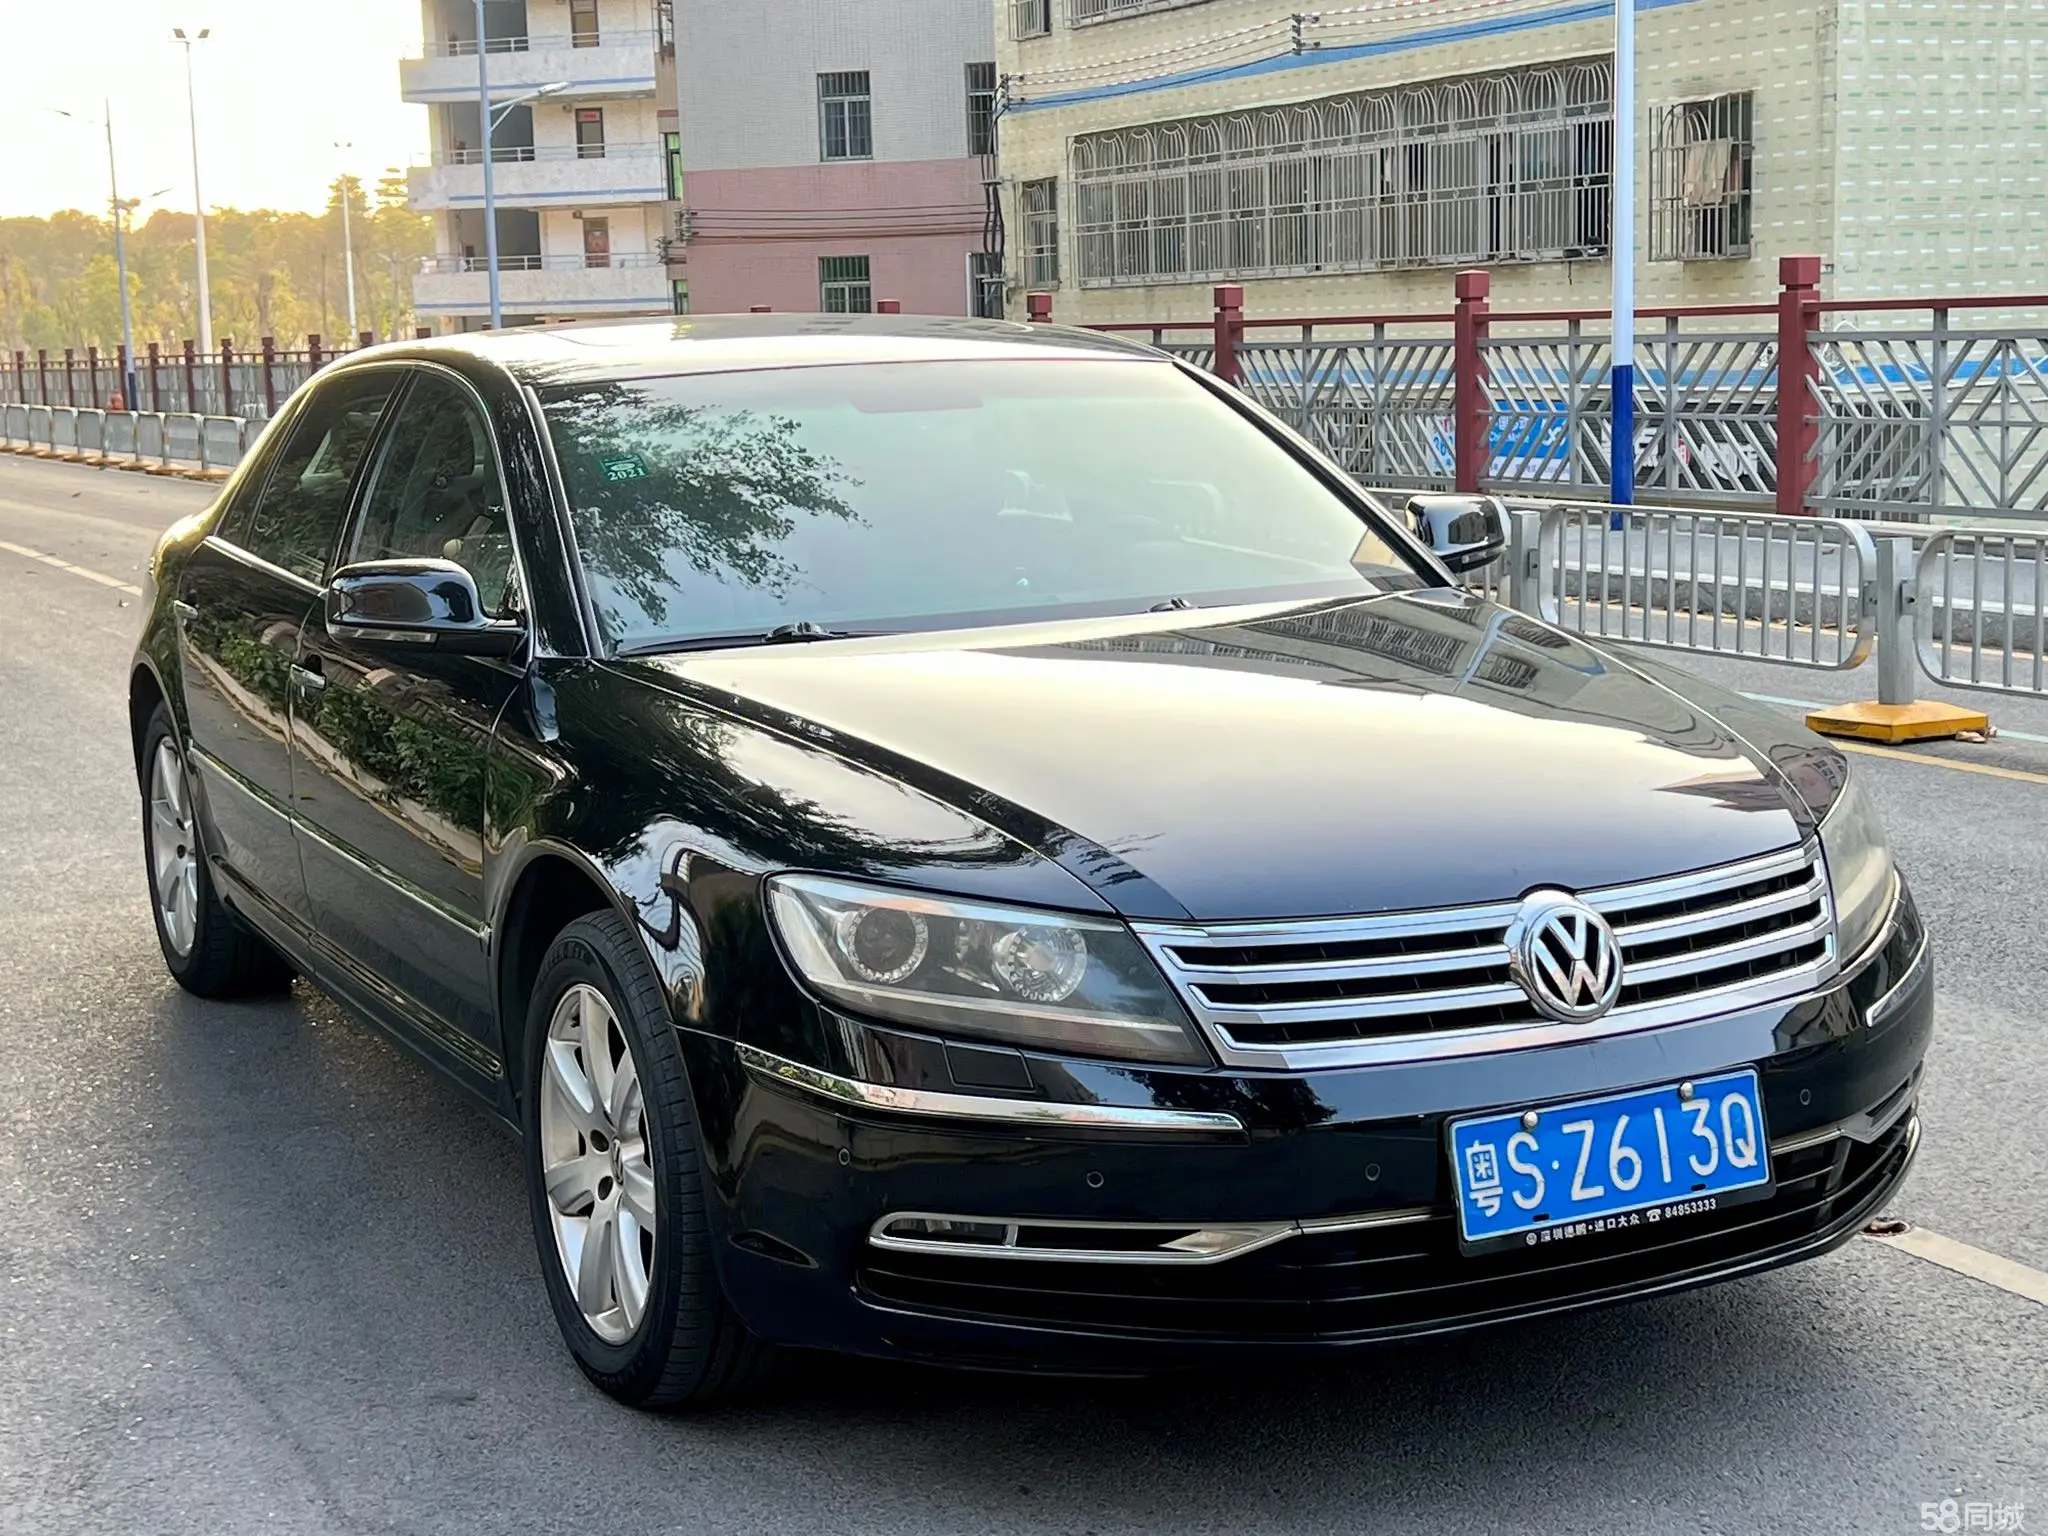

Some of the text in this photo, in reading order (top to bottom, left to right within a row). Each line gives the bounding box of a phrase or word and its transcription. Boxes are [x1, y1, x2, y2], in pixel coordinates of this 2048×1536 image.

[607, 467, 645, 481] 2021
[1531, 911, 1611, 1010] VW
[1664, 1198, 1717, 1219] 84853333
